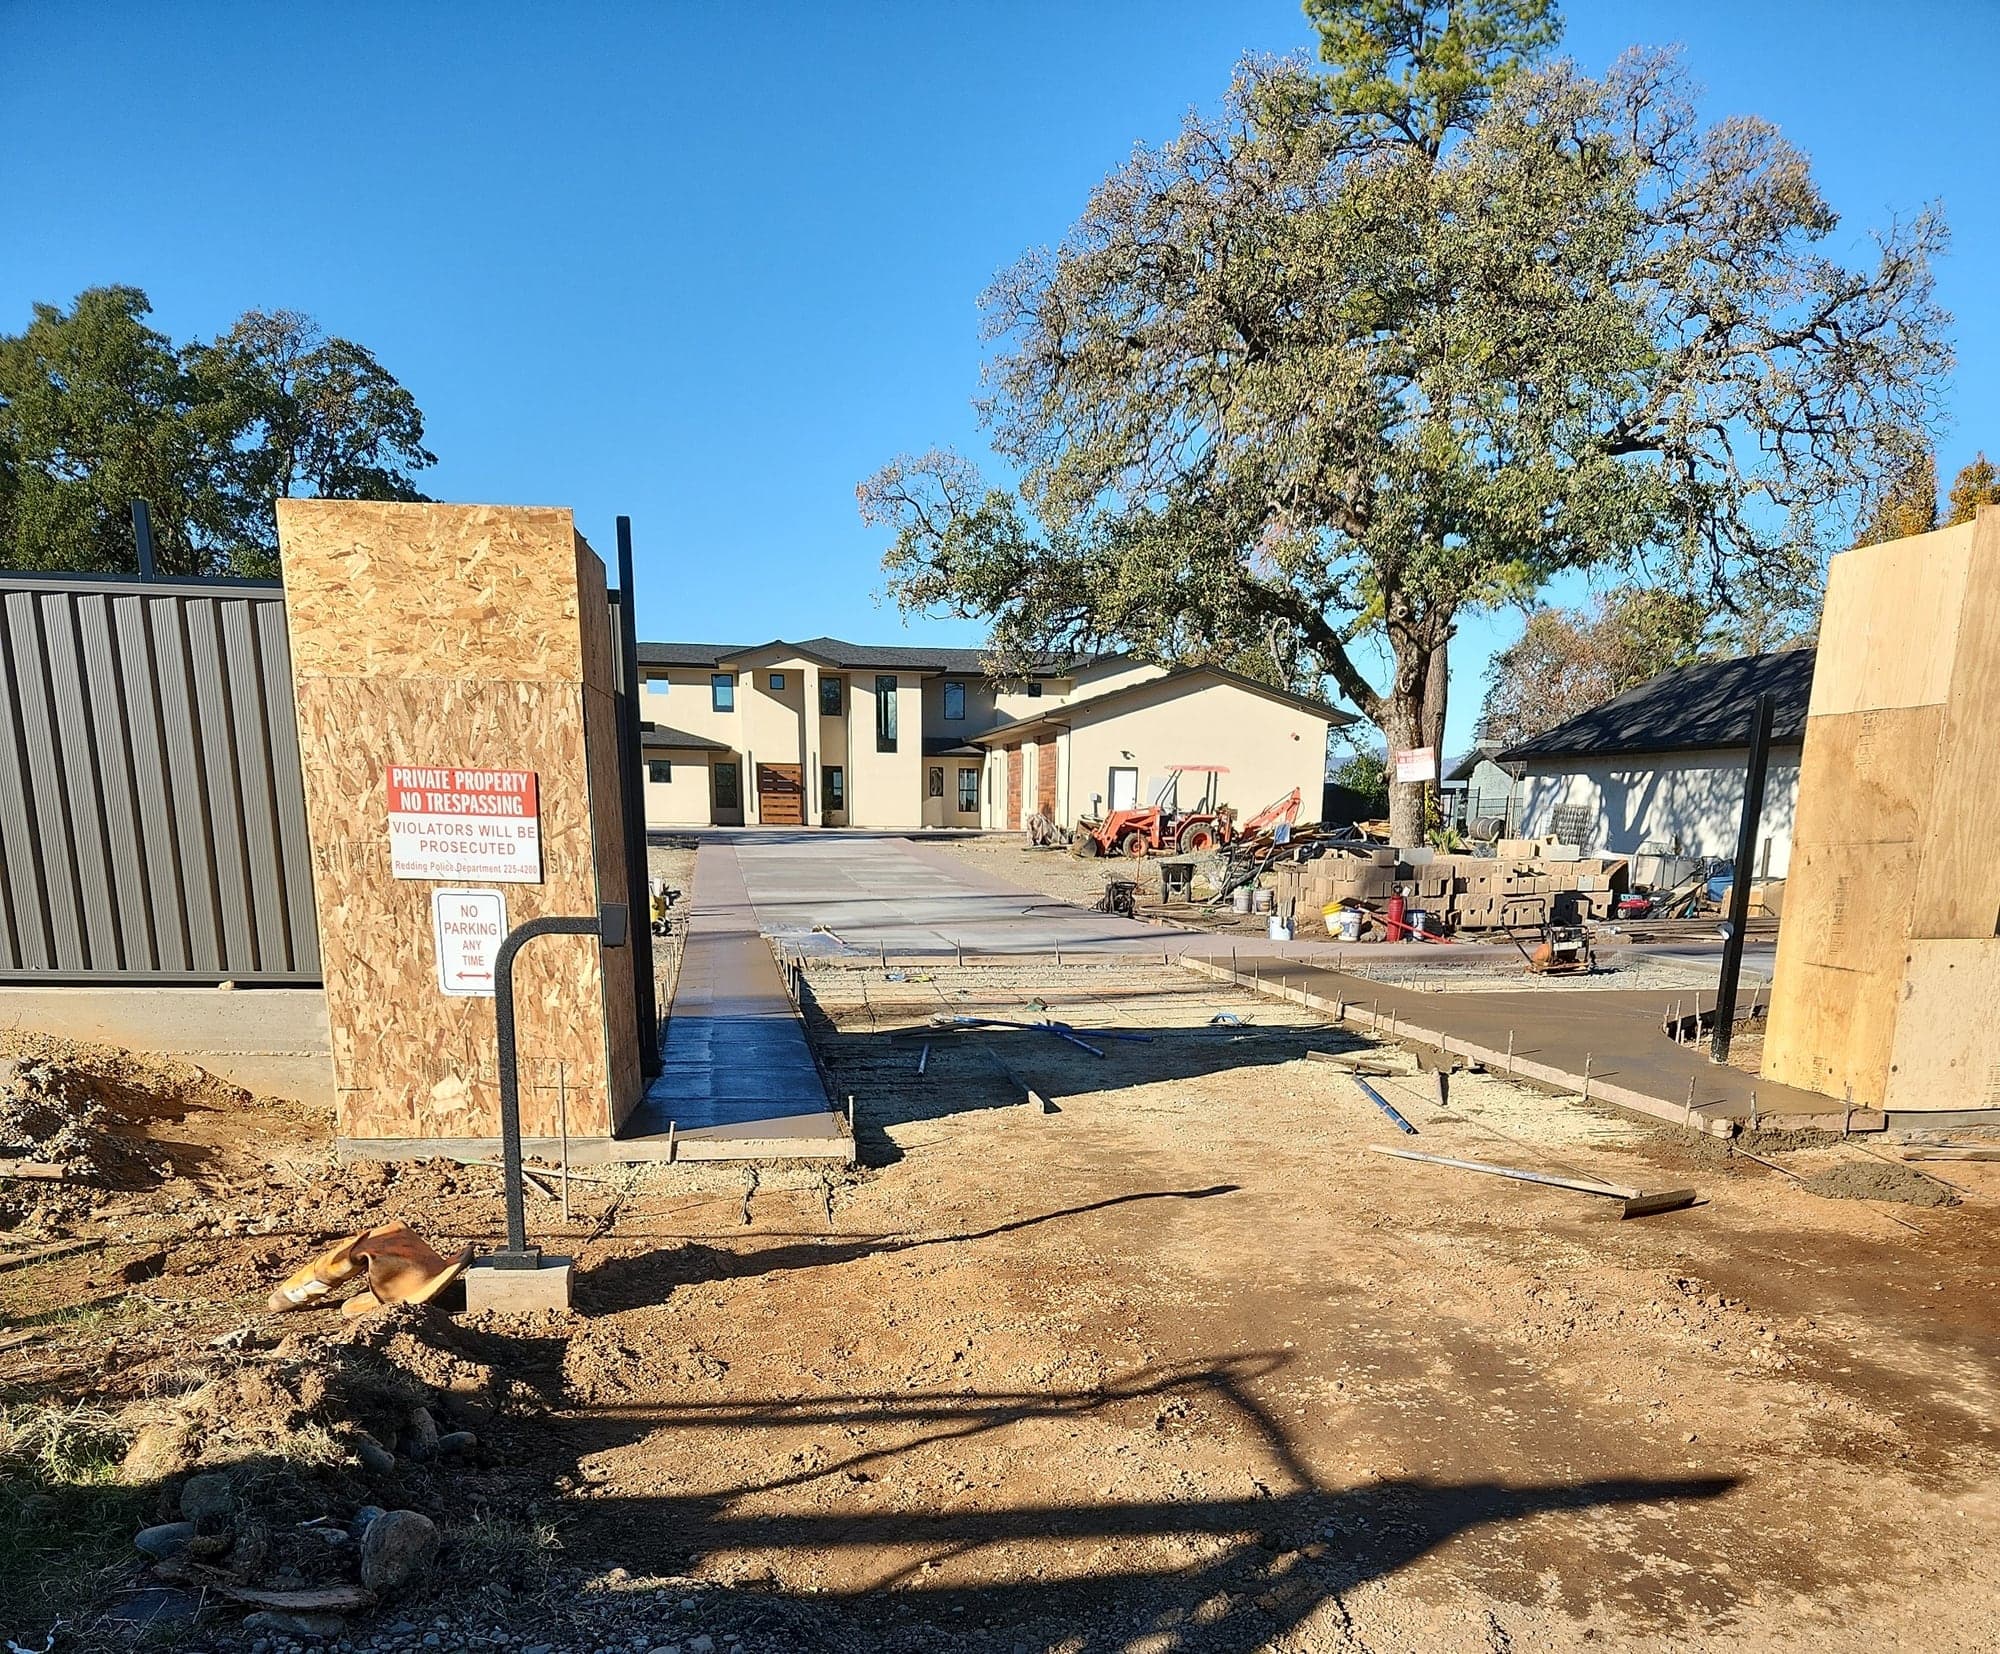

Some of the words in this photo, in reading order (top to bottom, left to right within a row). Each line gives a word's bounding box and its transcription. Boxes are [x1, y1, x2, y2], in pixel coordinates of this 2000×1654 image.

[392, 768, 450, 790] PRIVATE
[454, 771, 528, 792] PROPERTY
[400, 791, 422, 811] NO
[425, 792, 523, 816] TRESPASSING
[393, 821, 474, 836] VIOLATORS
[478, 825, 513, 838] WILL
[517, 826, 536, 838] BE
[420, 840, 516, 855] PROSECUTED
[395, 860, 428, 873] Redding
[430, 861, 454, 872] Police
[456, 863, 501, 874] Department
[460, 904, 478, 918] NO
[444, 922, 497, 936] PARKING
[462, 940, 482, 951] ANY
[461, 955, 485, 967] TIME
